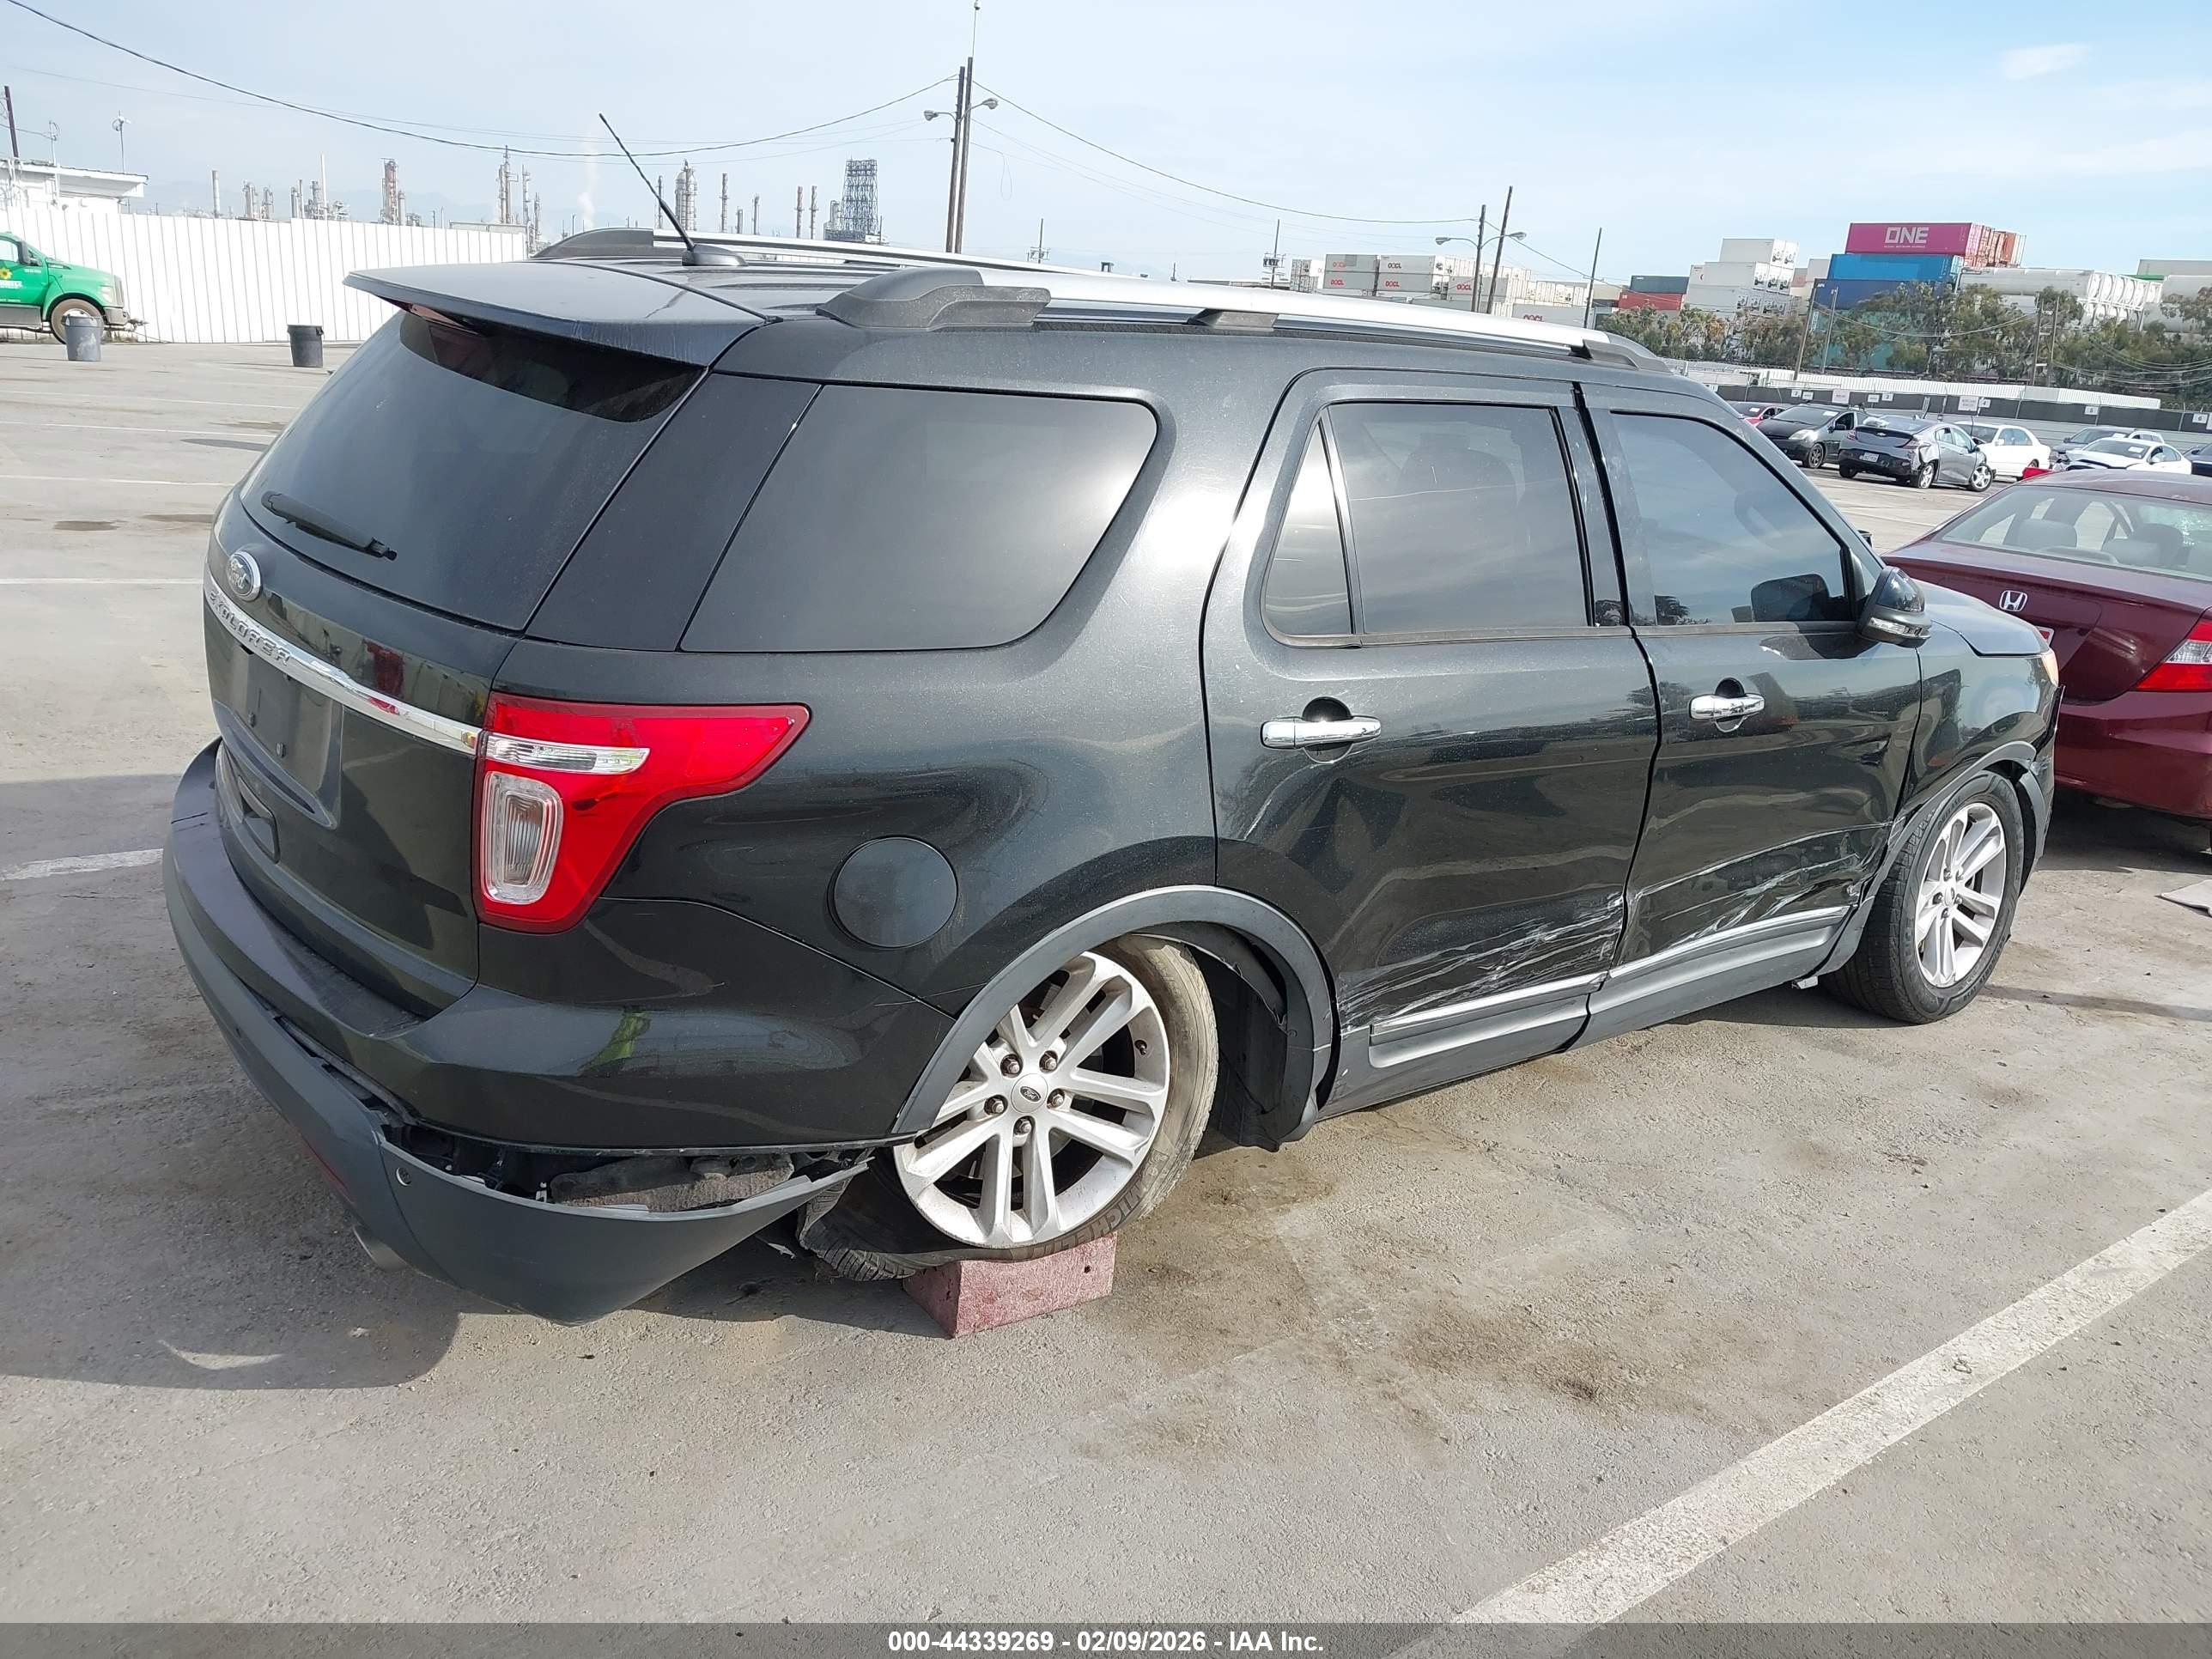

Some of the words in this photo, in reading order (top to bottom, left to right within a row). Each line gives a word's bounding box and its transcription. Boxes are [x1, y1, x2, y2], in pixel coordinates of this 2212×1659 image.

[1884, 227, 1929, 244] ONE
[229, 557, 247, 589] Ford
[210, 589, 291, 667] EXPLORER
